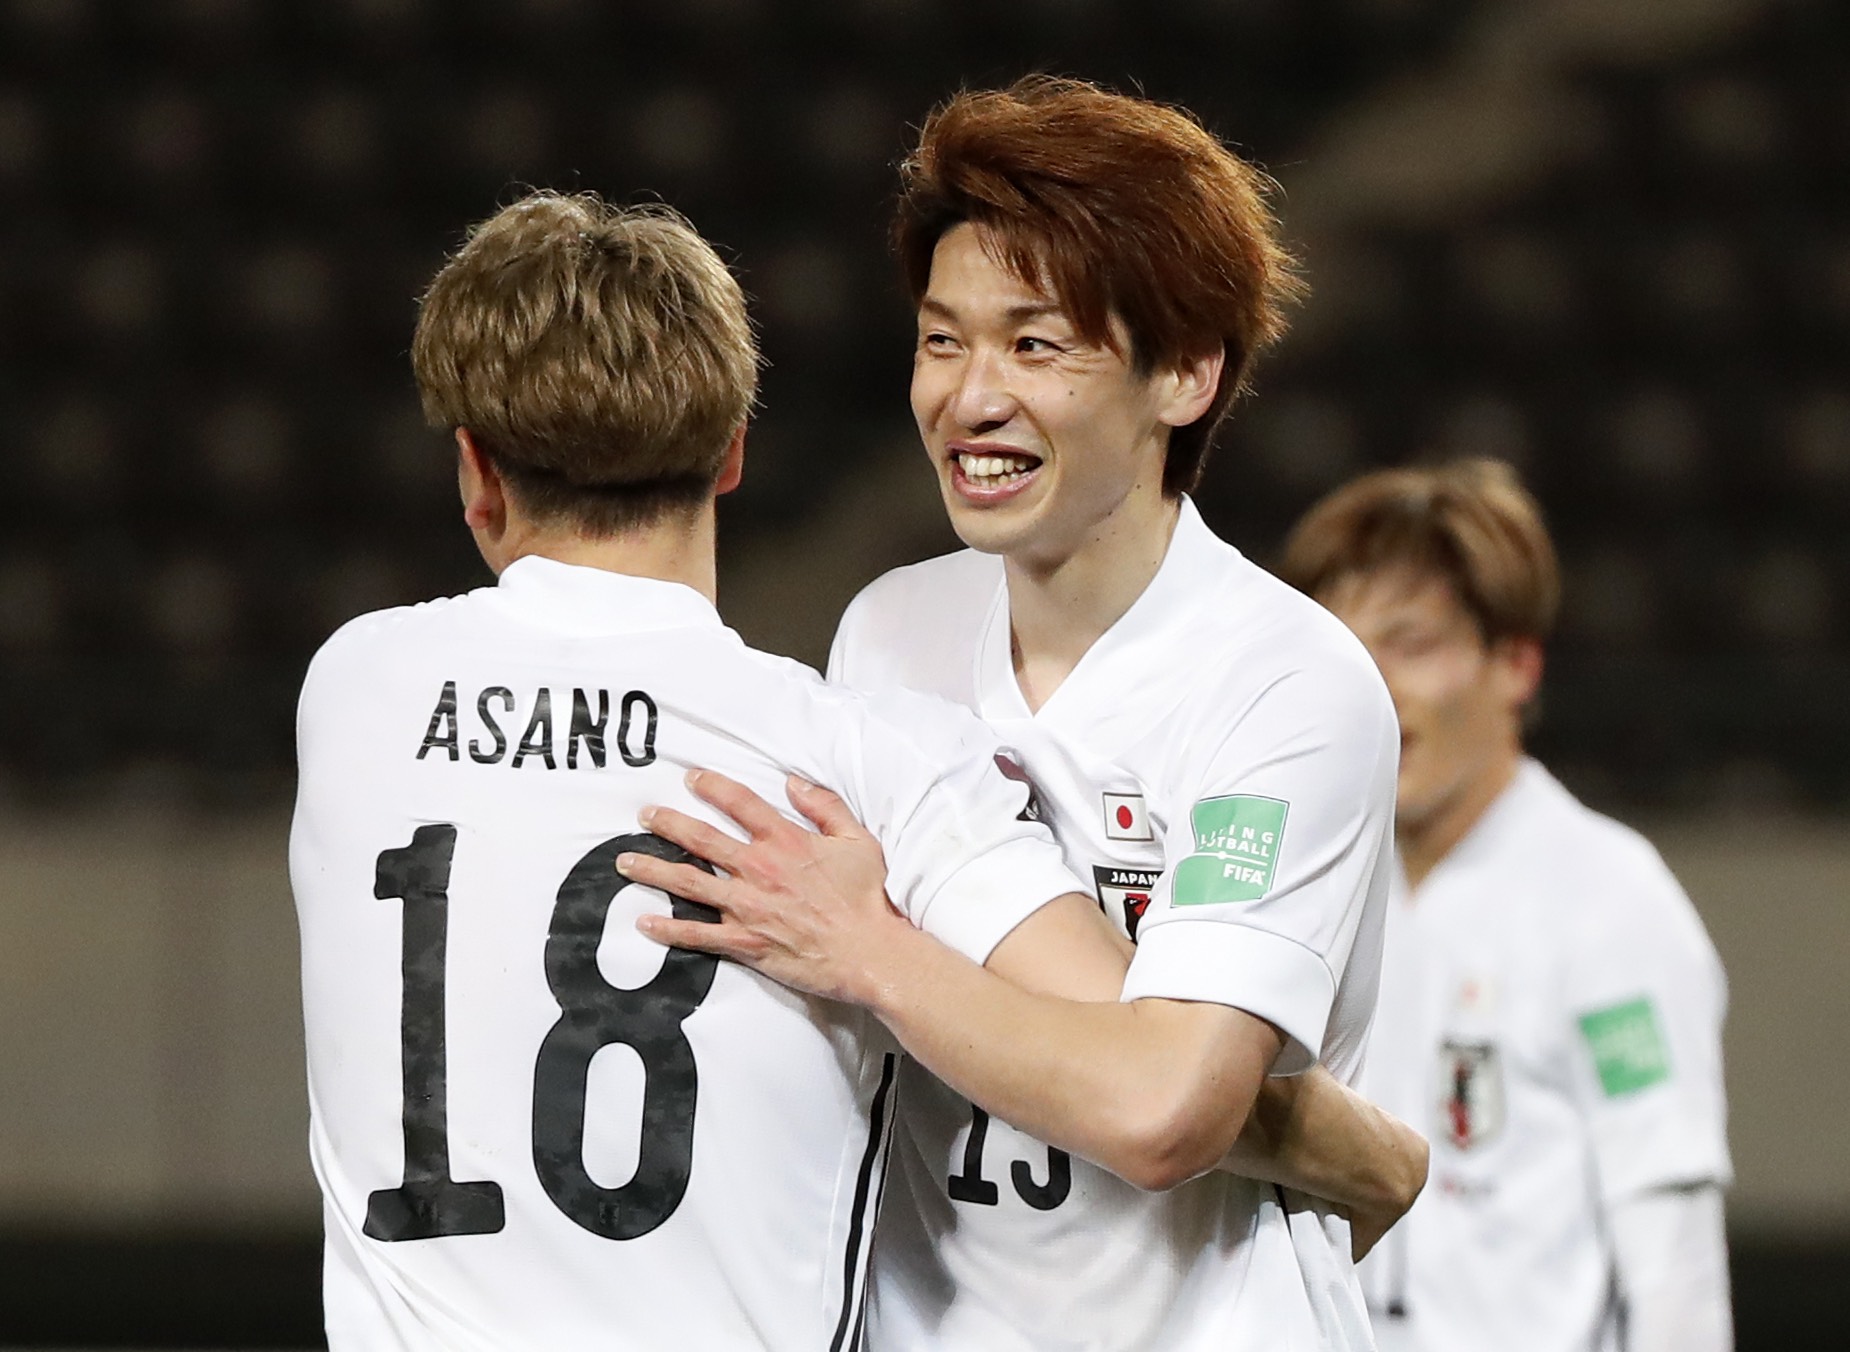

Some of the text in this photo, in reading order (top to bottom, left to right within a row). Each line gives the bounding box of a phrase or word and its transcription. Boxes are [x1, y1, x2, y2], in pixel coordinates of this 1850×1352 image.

[416, 680, 658, 769] ASANO
[1111, 871, 1158, 885] JAPAN
[1223, 863, 1263, 886] FIFA
[363, 824, 721, 1242] 18
